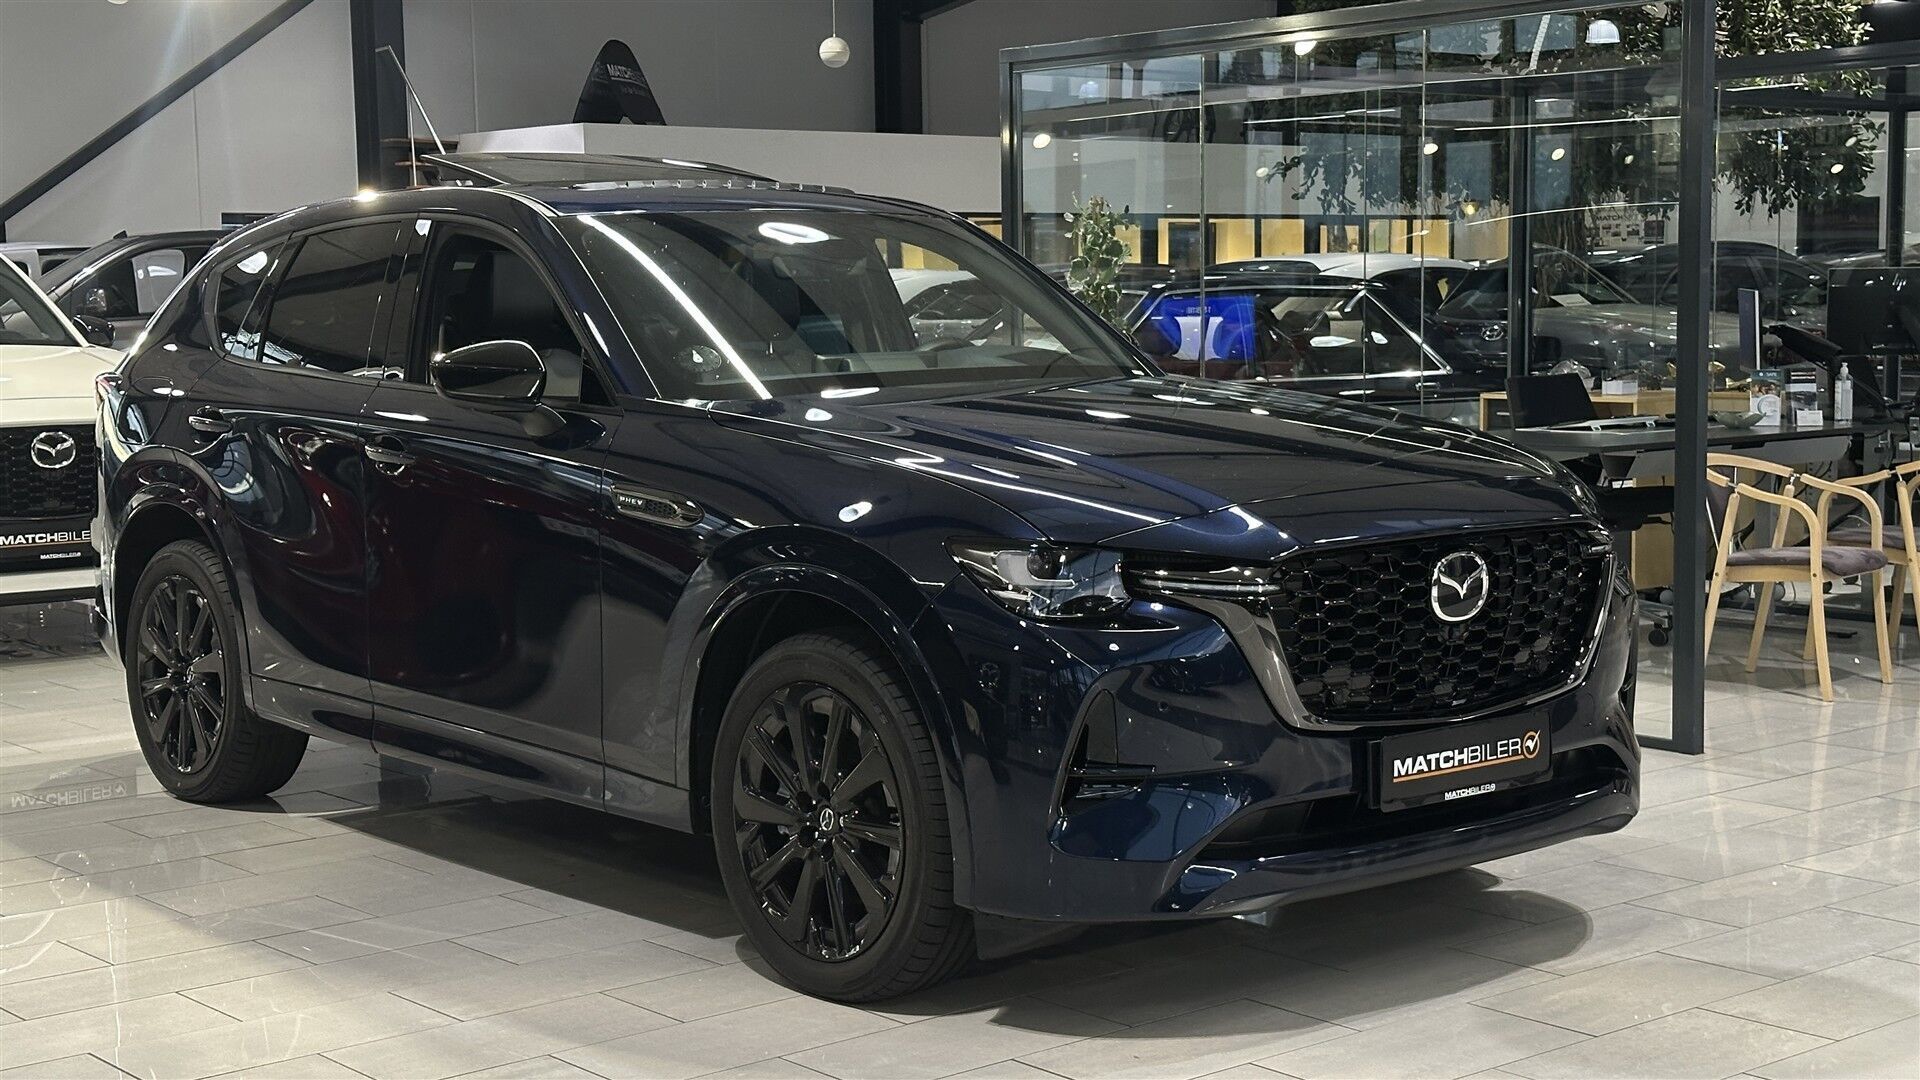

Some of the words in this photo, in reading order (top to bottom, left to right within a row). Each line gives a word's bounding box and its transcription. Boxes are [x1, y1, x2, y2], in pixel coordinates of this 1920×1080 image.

[619, 496, 643, 505] PHEV
[0, 530, 91, 545] MATCHBILE
[1393, 737, 1522, 777] MATCHBILER
[1445, 784, 1492, 800] MATCHBILER
